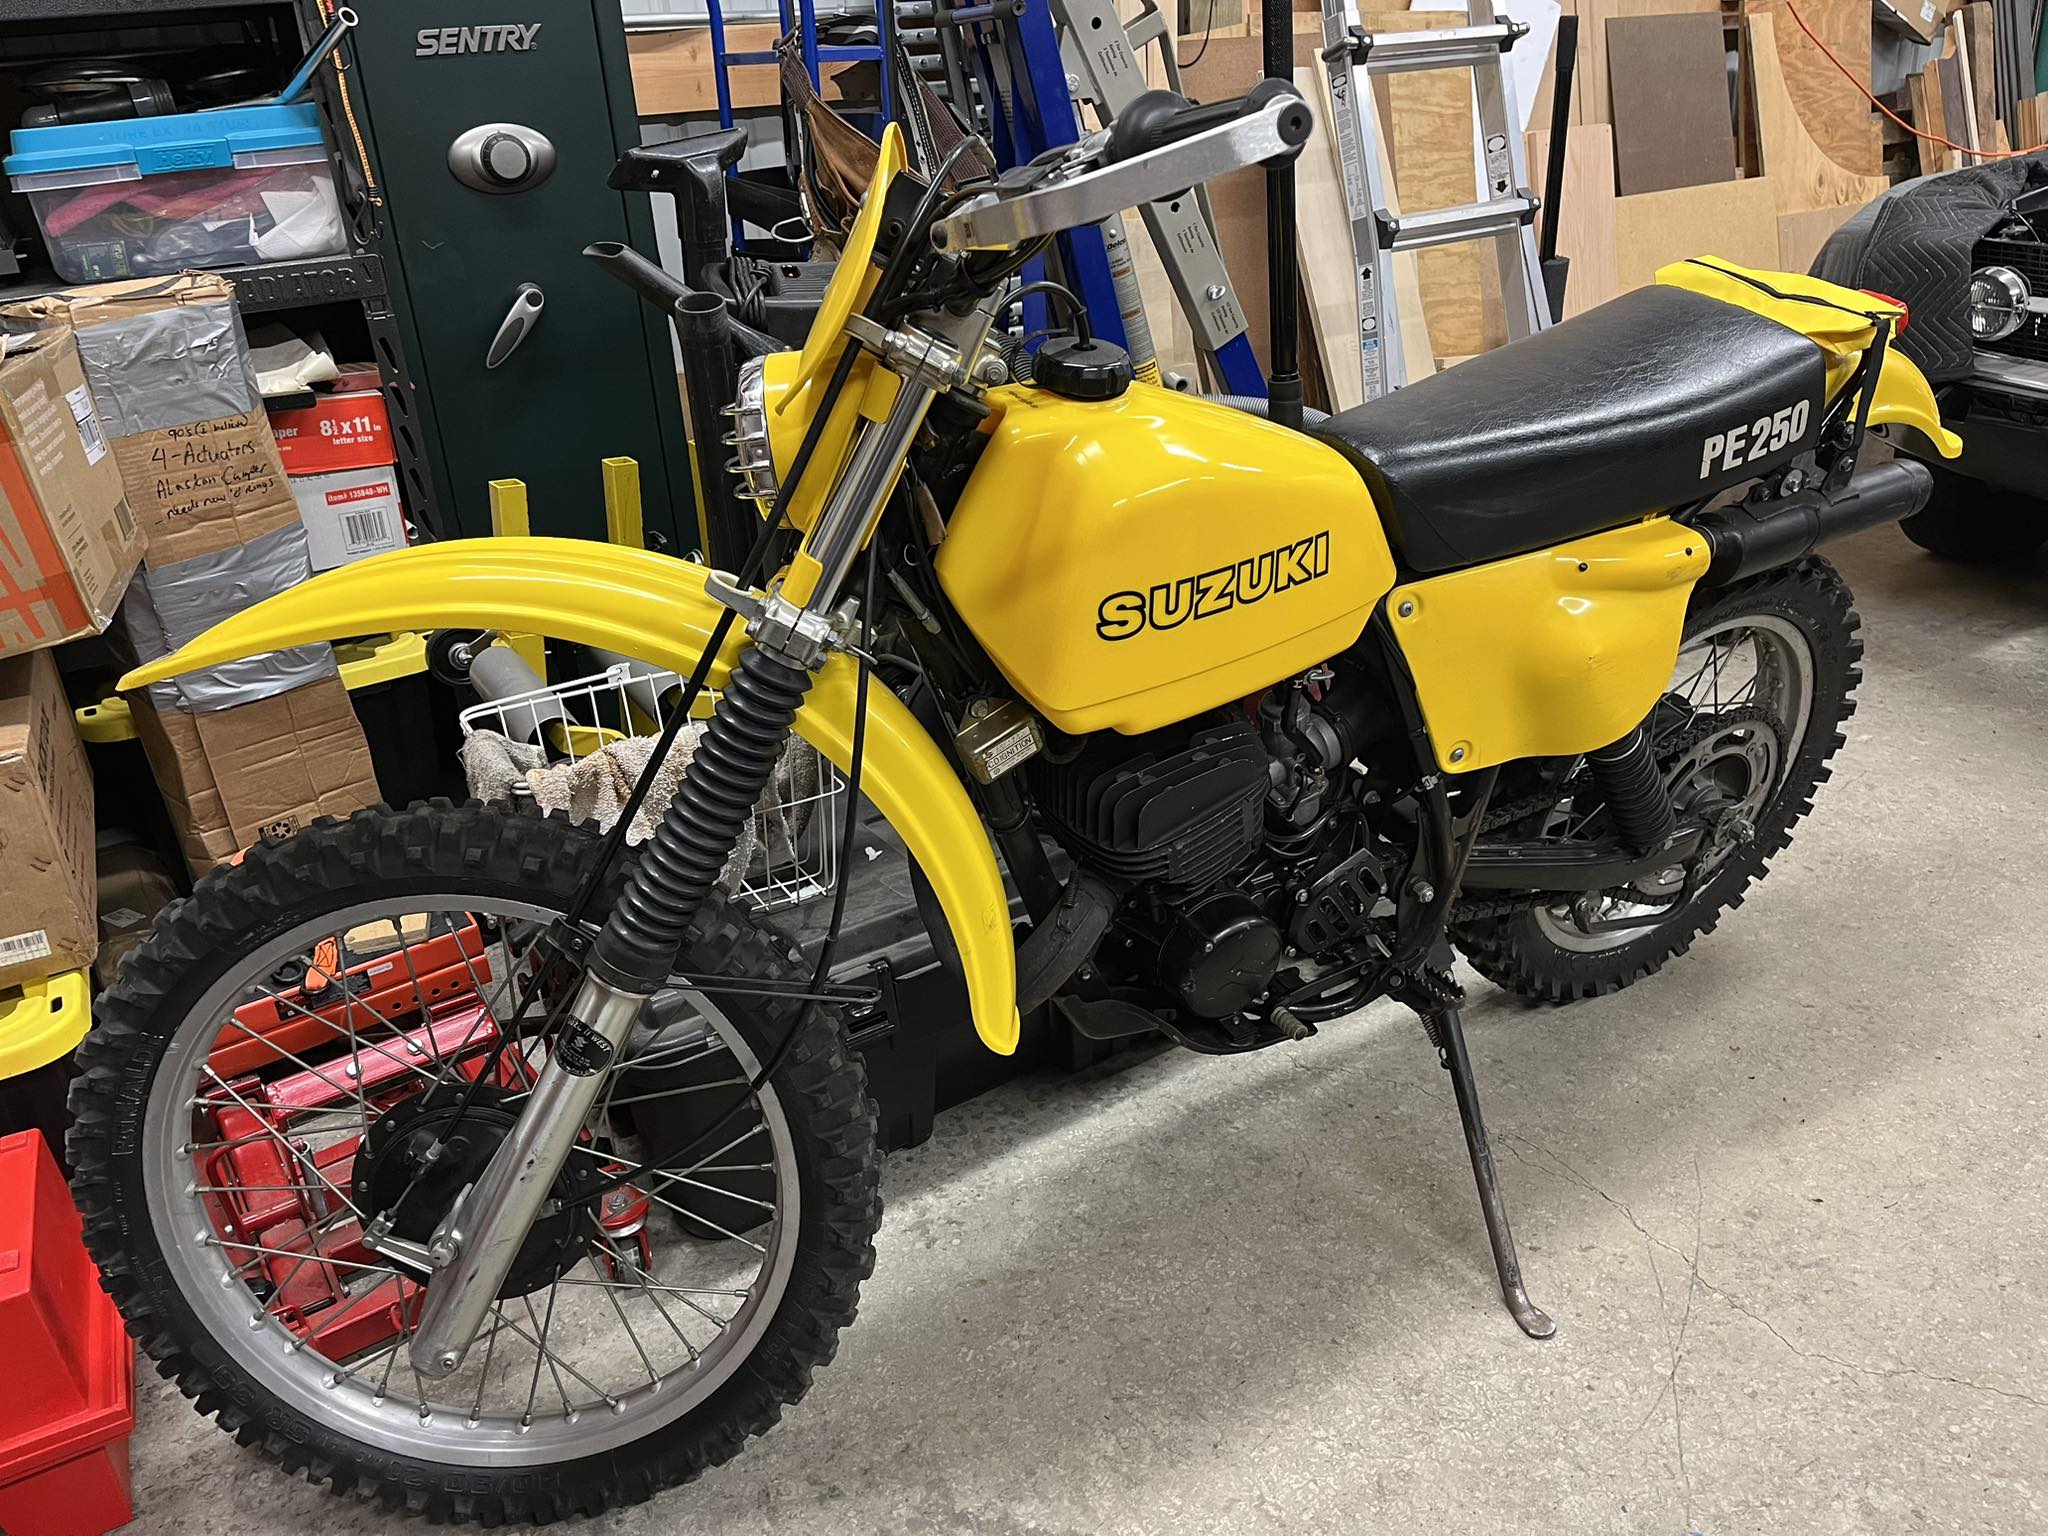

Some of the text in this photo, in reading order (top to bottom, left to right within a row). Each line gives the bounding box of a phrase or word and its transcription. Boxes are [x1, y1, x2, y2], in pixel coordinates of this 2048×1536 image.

[415, 23, 542, 57] SENTRY
[238, 267, 357, 303] ADIATOR
[272, 427, 299, 440] aper
[332, 434, 374, 446] letter size
[1096, 529, 1330, 642] SUZUKI
[590, 1034, 611, 1052] WEST
